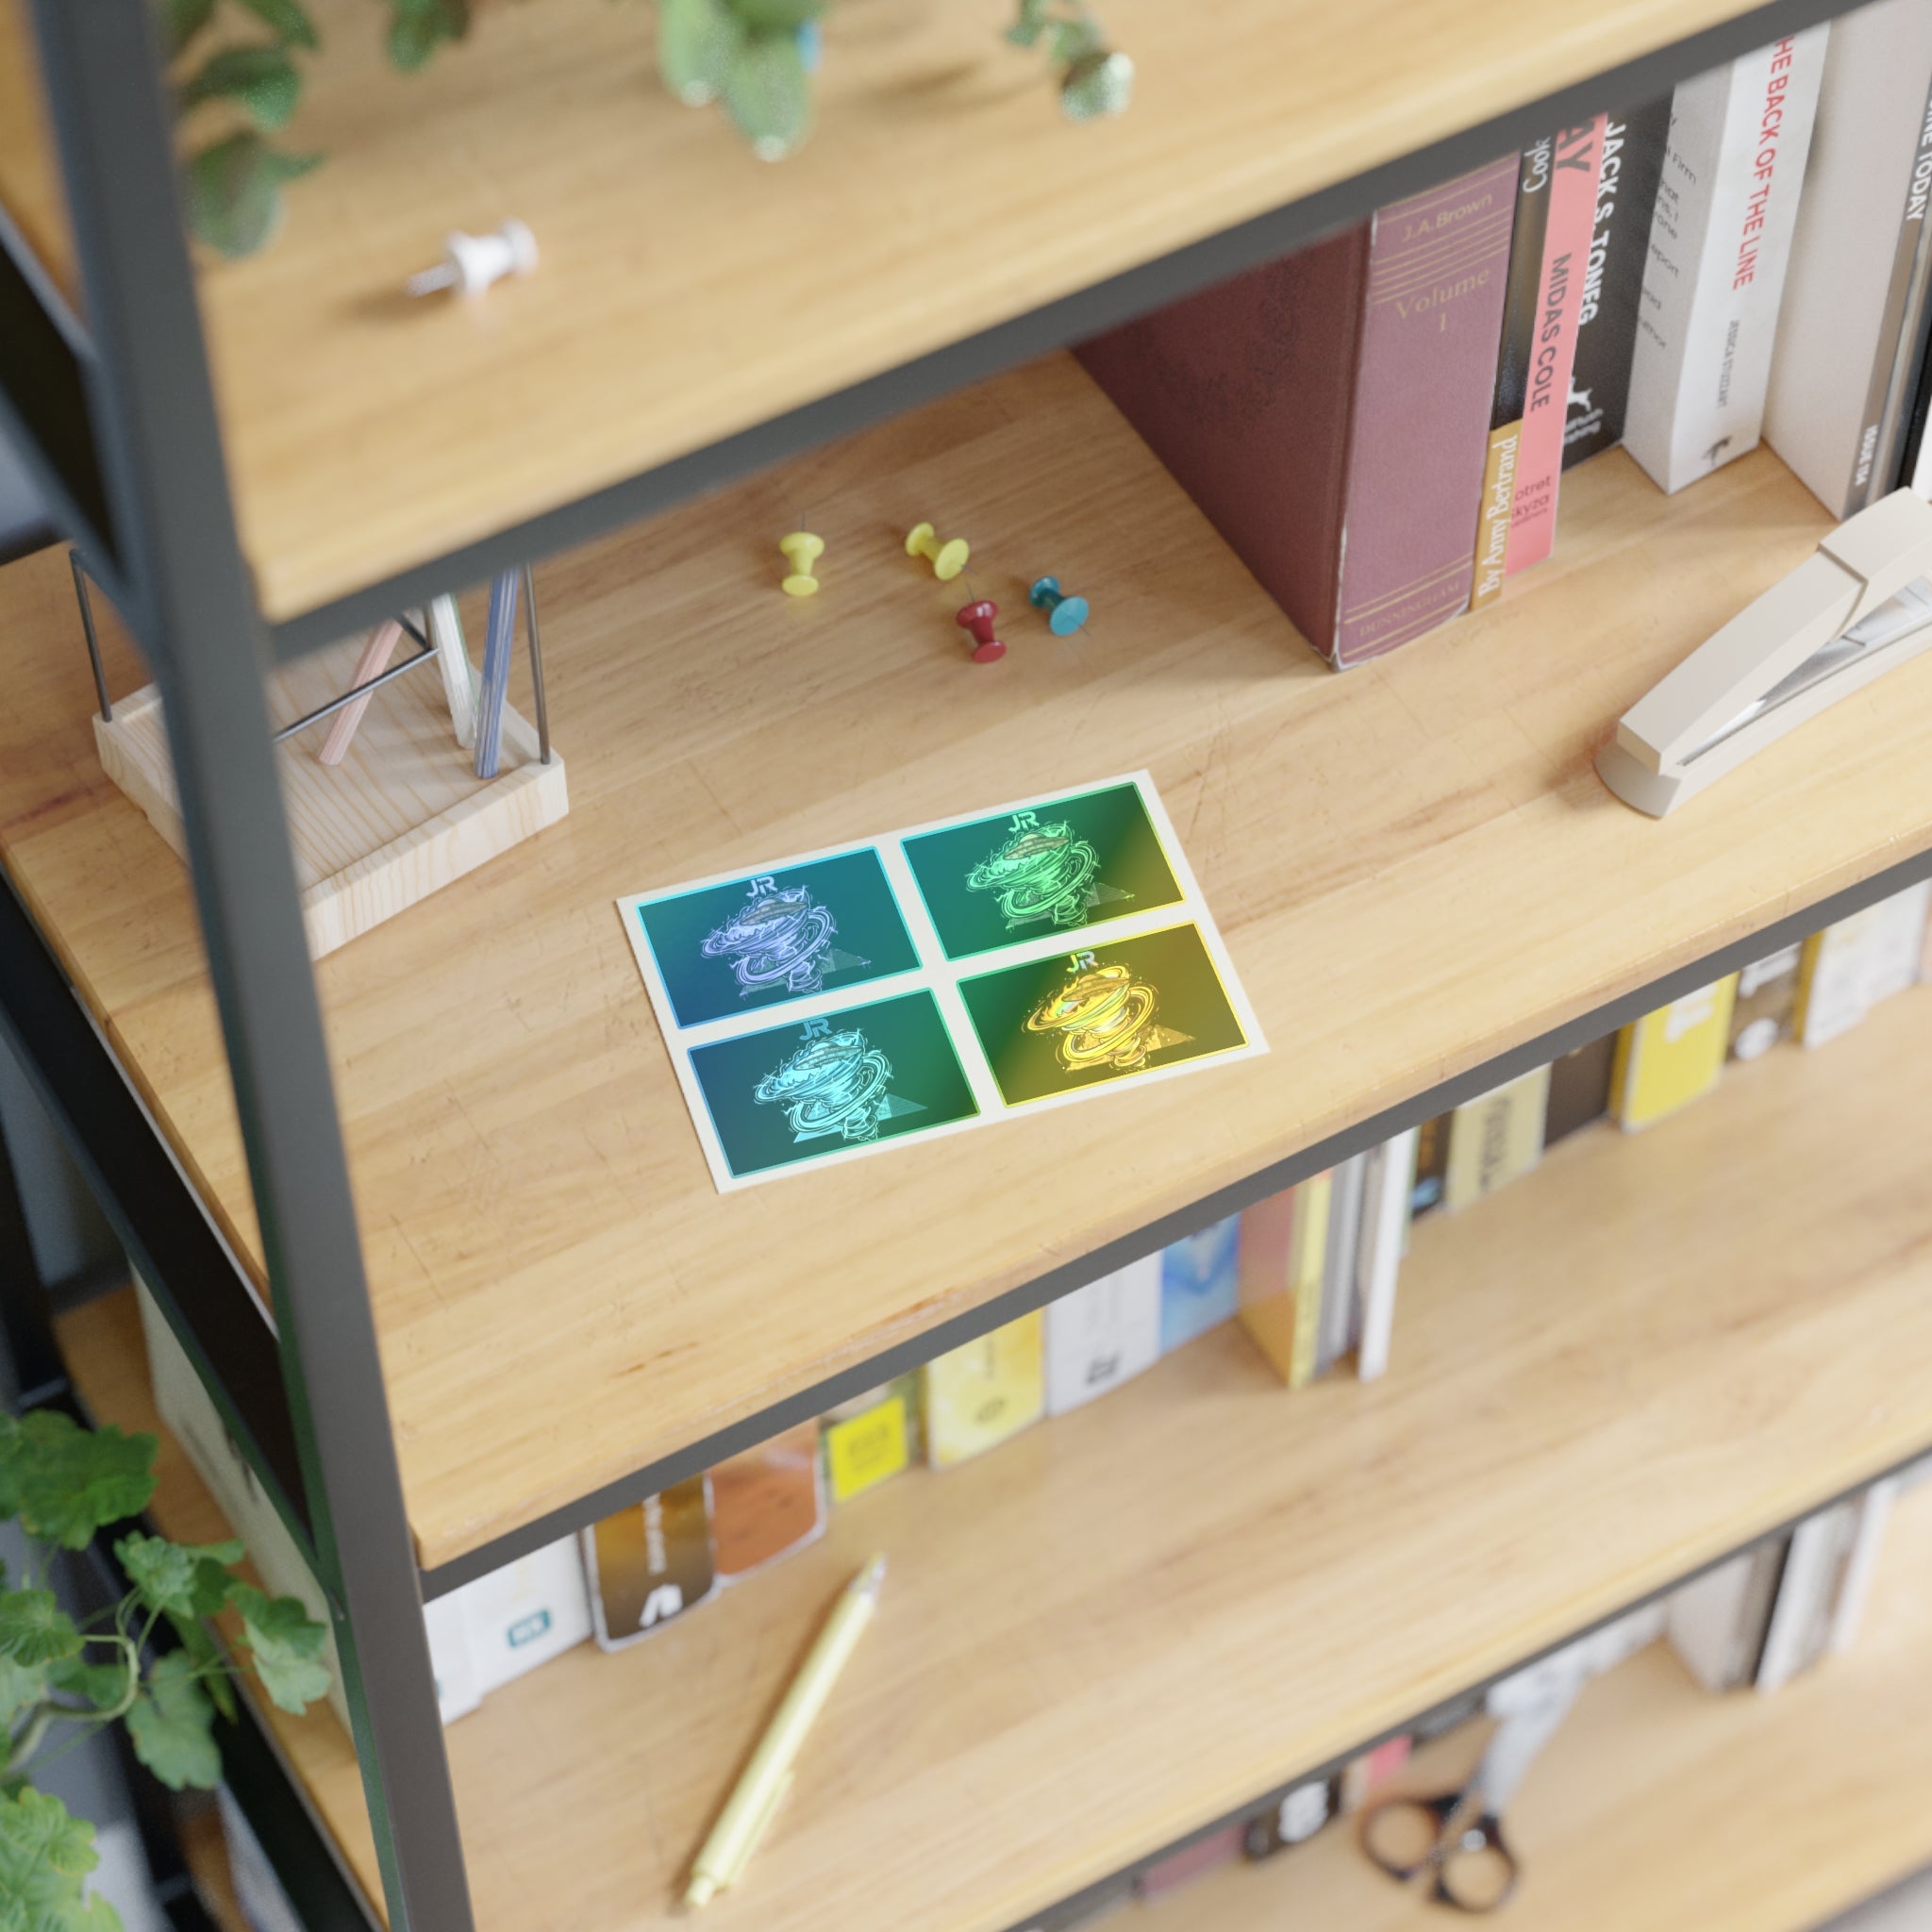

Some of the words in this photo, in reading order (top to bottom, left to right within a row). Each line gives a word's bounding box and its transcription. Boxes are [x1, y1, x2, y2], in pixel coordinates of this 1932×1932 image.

[1758, 75, 1789, 145] BACK
[1597, 122, 1626, 200] JACK
[1754, 148, 1776, 180] OF
[1743, 184, 1770, 236] THE
[1579, 229, 1609, 325] TONEG
[1732, 236, 1760, 291] LINE
[1395, 269, 1491, 320] Volume
[1541, 251, 1573, 343] MIDAS
[1530, 346, 1557, 413] COLE
[1486, 434, 1518, 521] Bertrand
[1477, 568, 1507, 598] By
[1007, 810, 1041, 833] JR
[745, 874, 778, 898] JR
[1066, 950, 1099, 974] JR
[798, 1018, 833, 1041] JR
